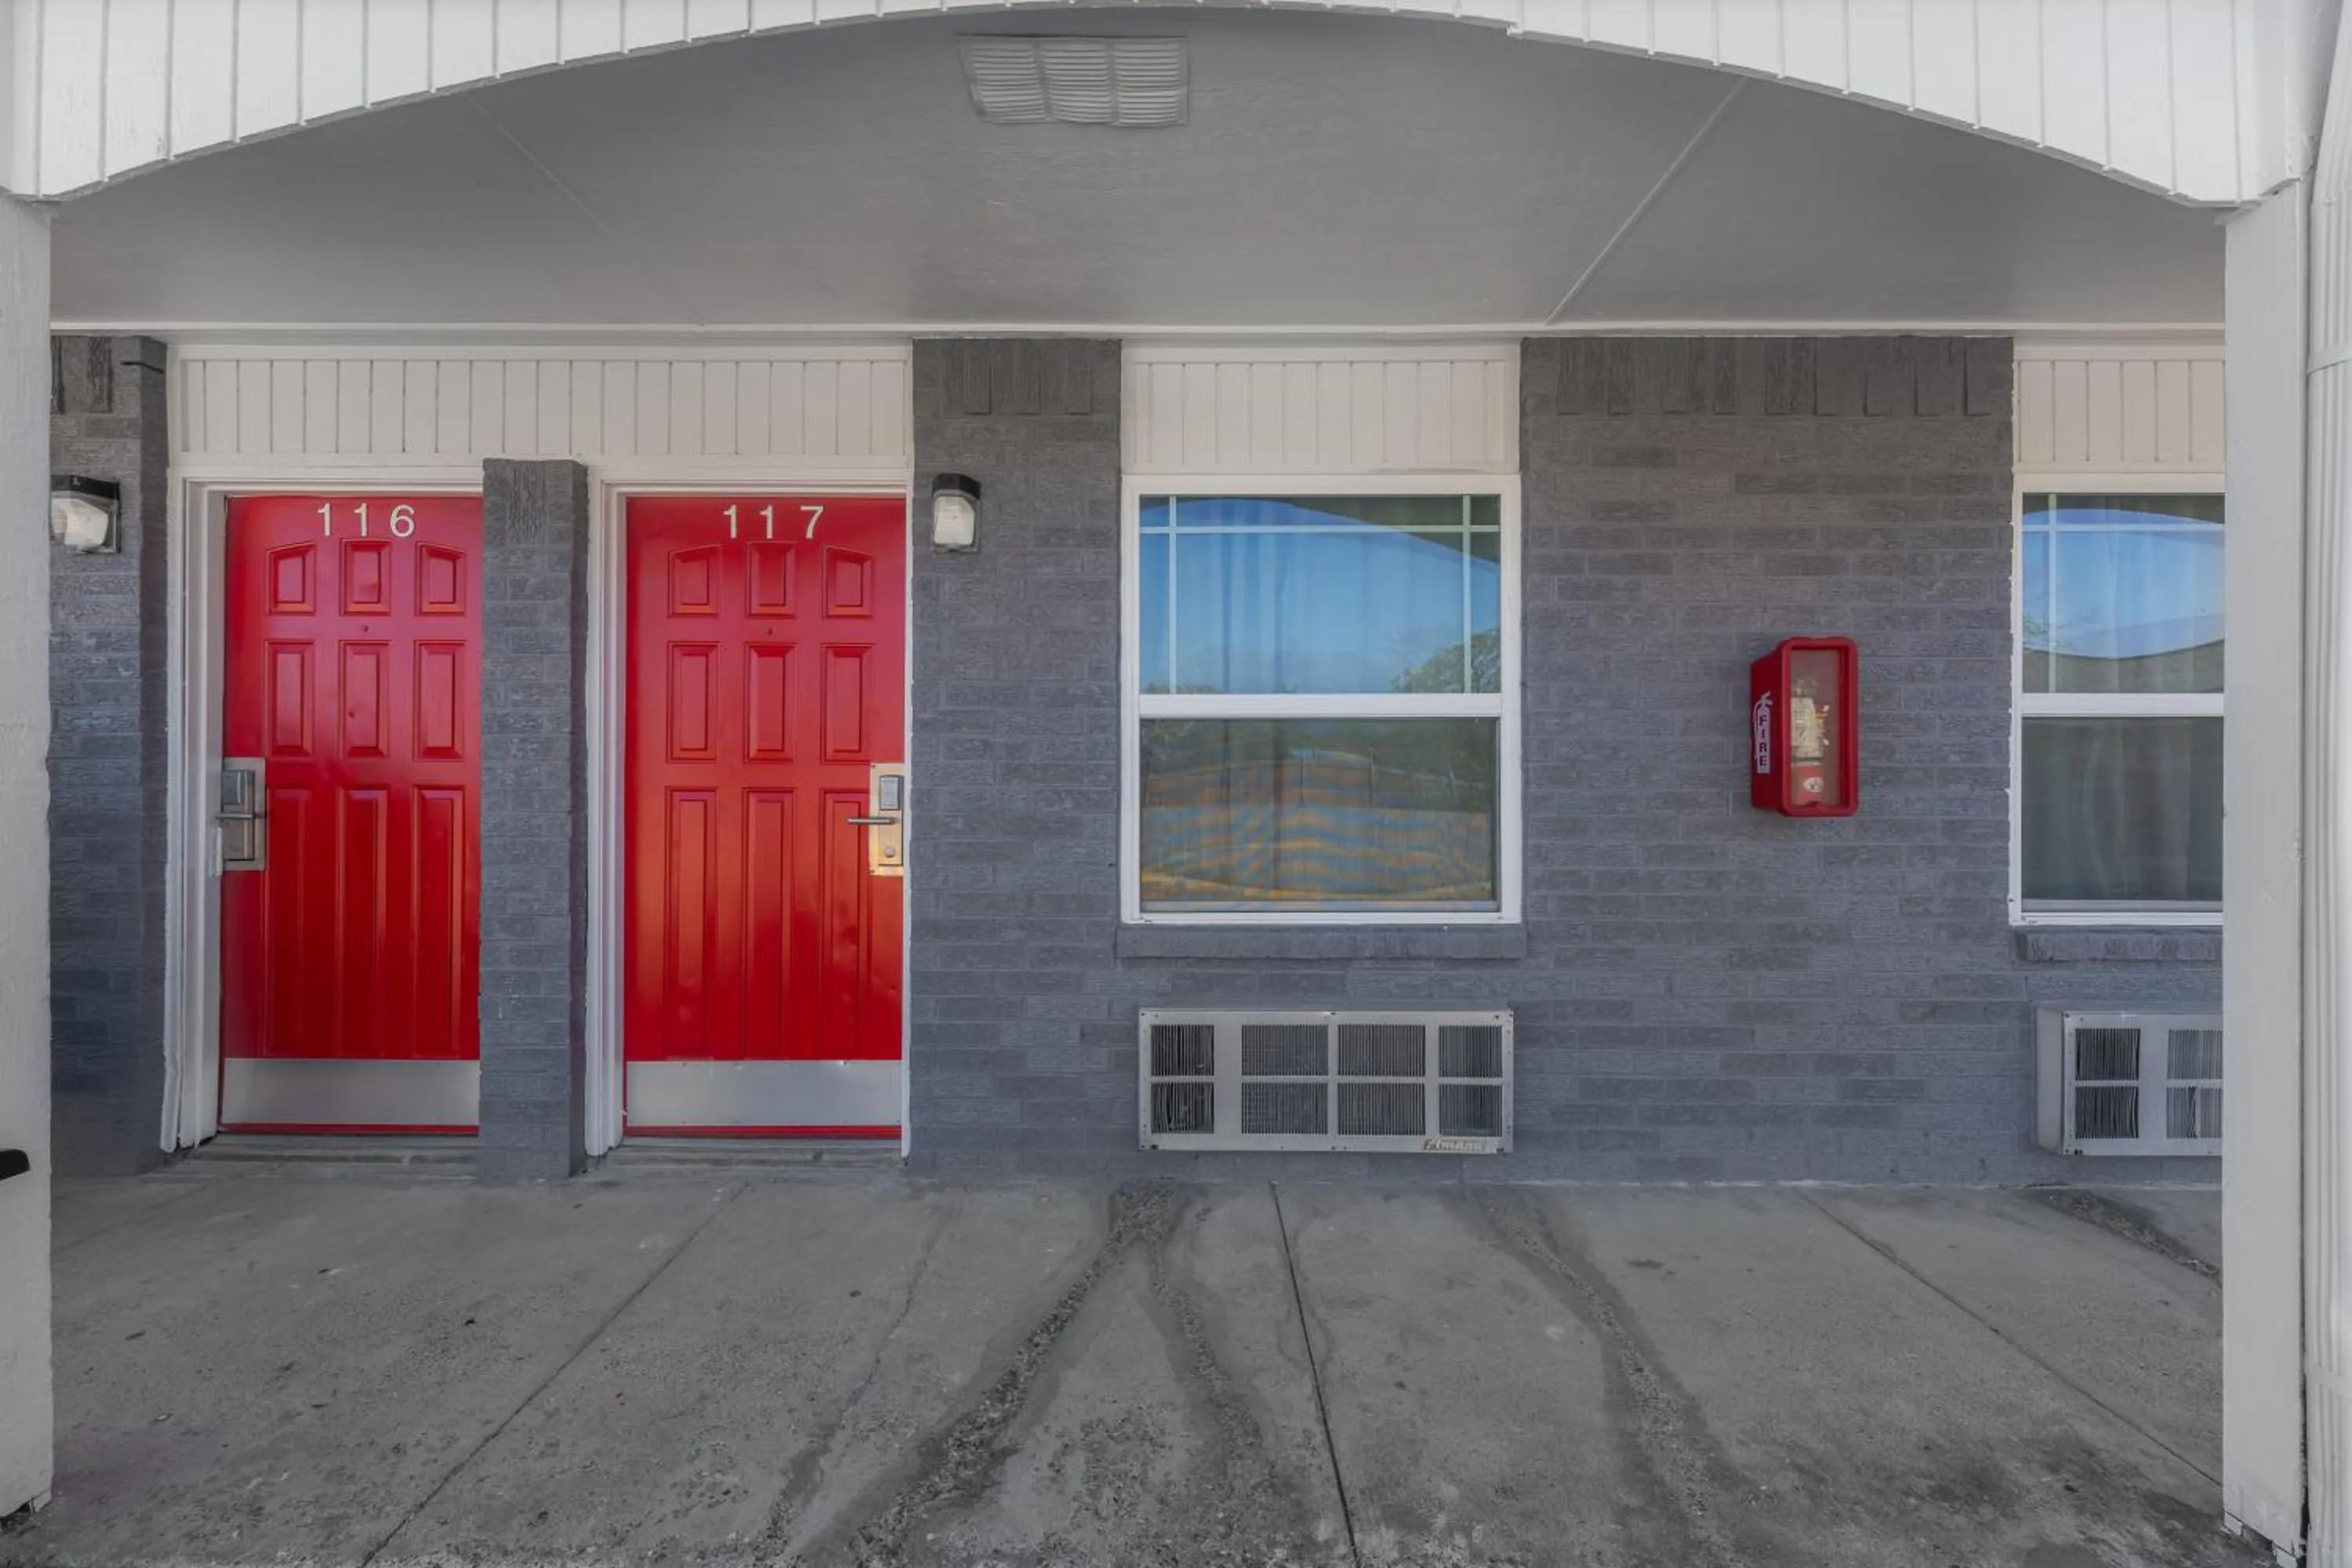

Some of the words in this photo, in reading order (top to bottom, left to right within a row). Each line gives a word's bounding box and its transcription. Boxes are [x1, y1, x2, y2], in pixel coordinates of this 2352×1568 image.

[317, 502, 416, 538] 116
[723, 504, 824, 539] 117
[1759, 714, 1768, 767] FIRE
